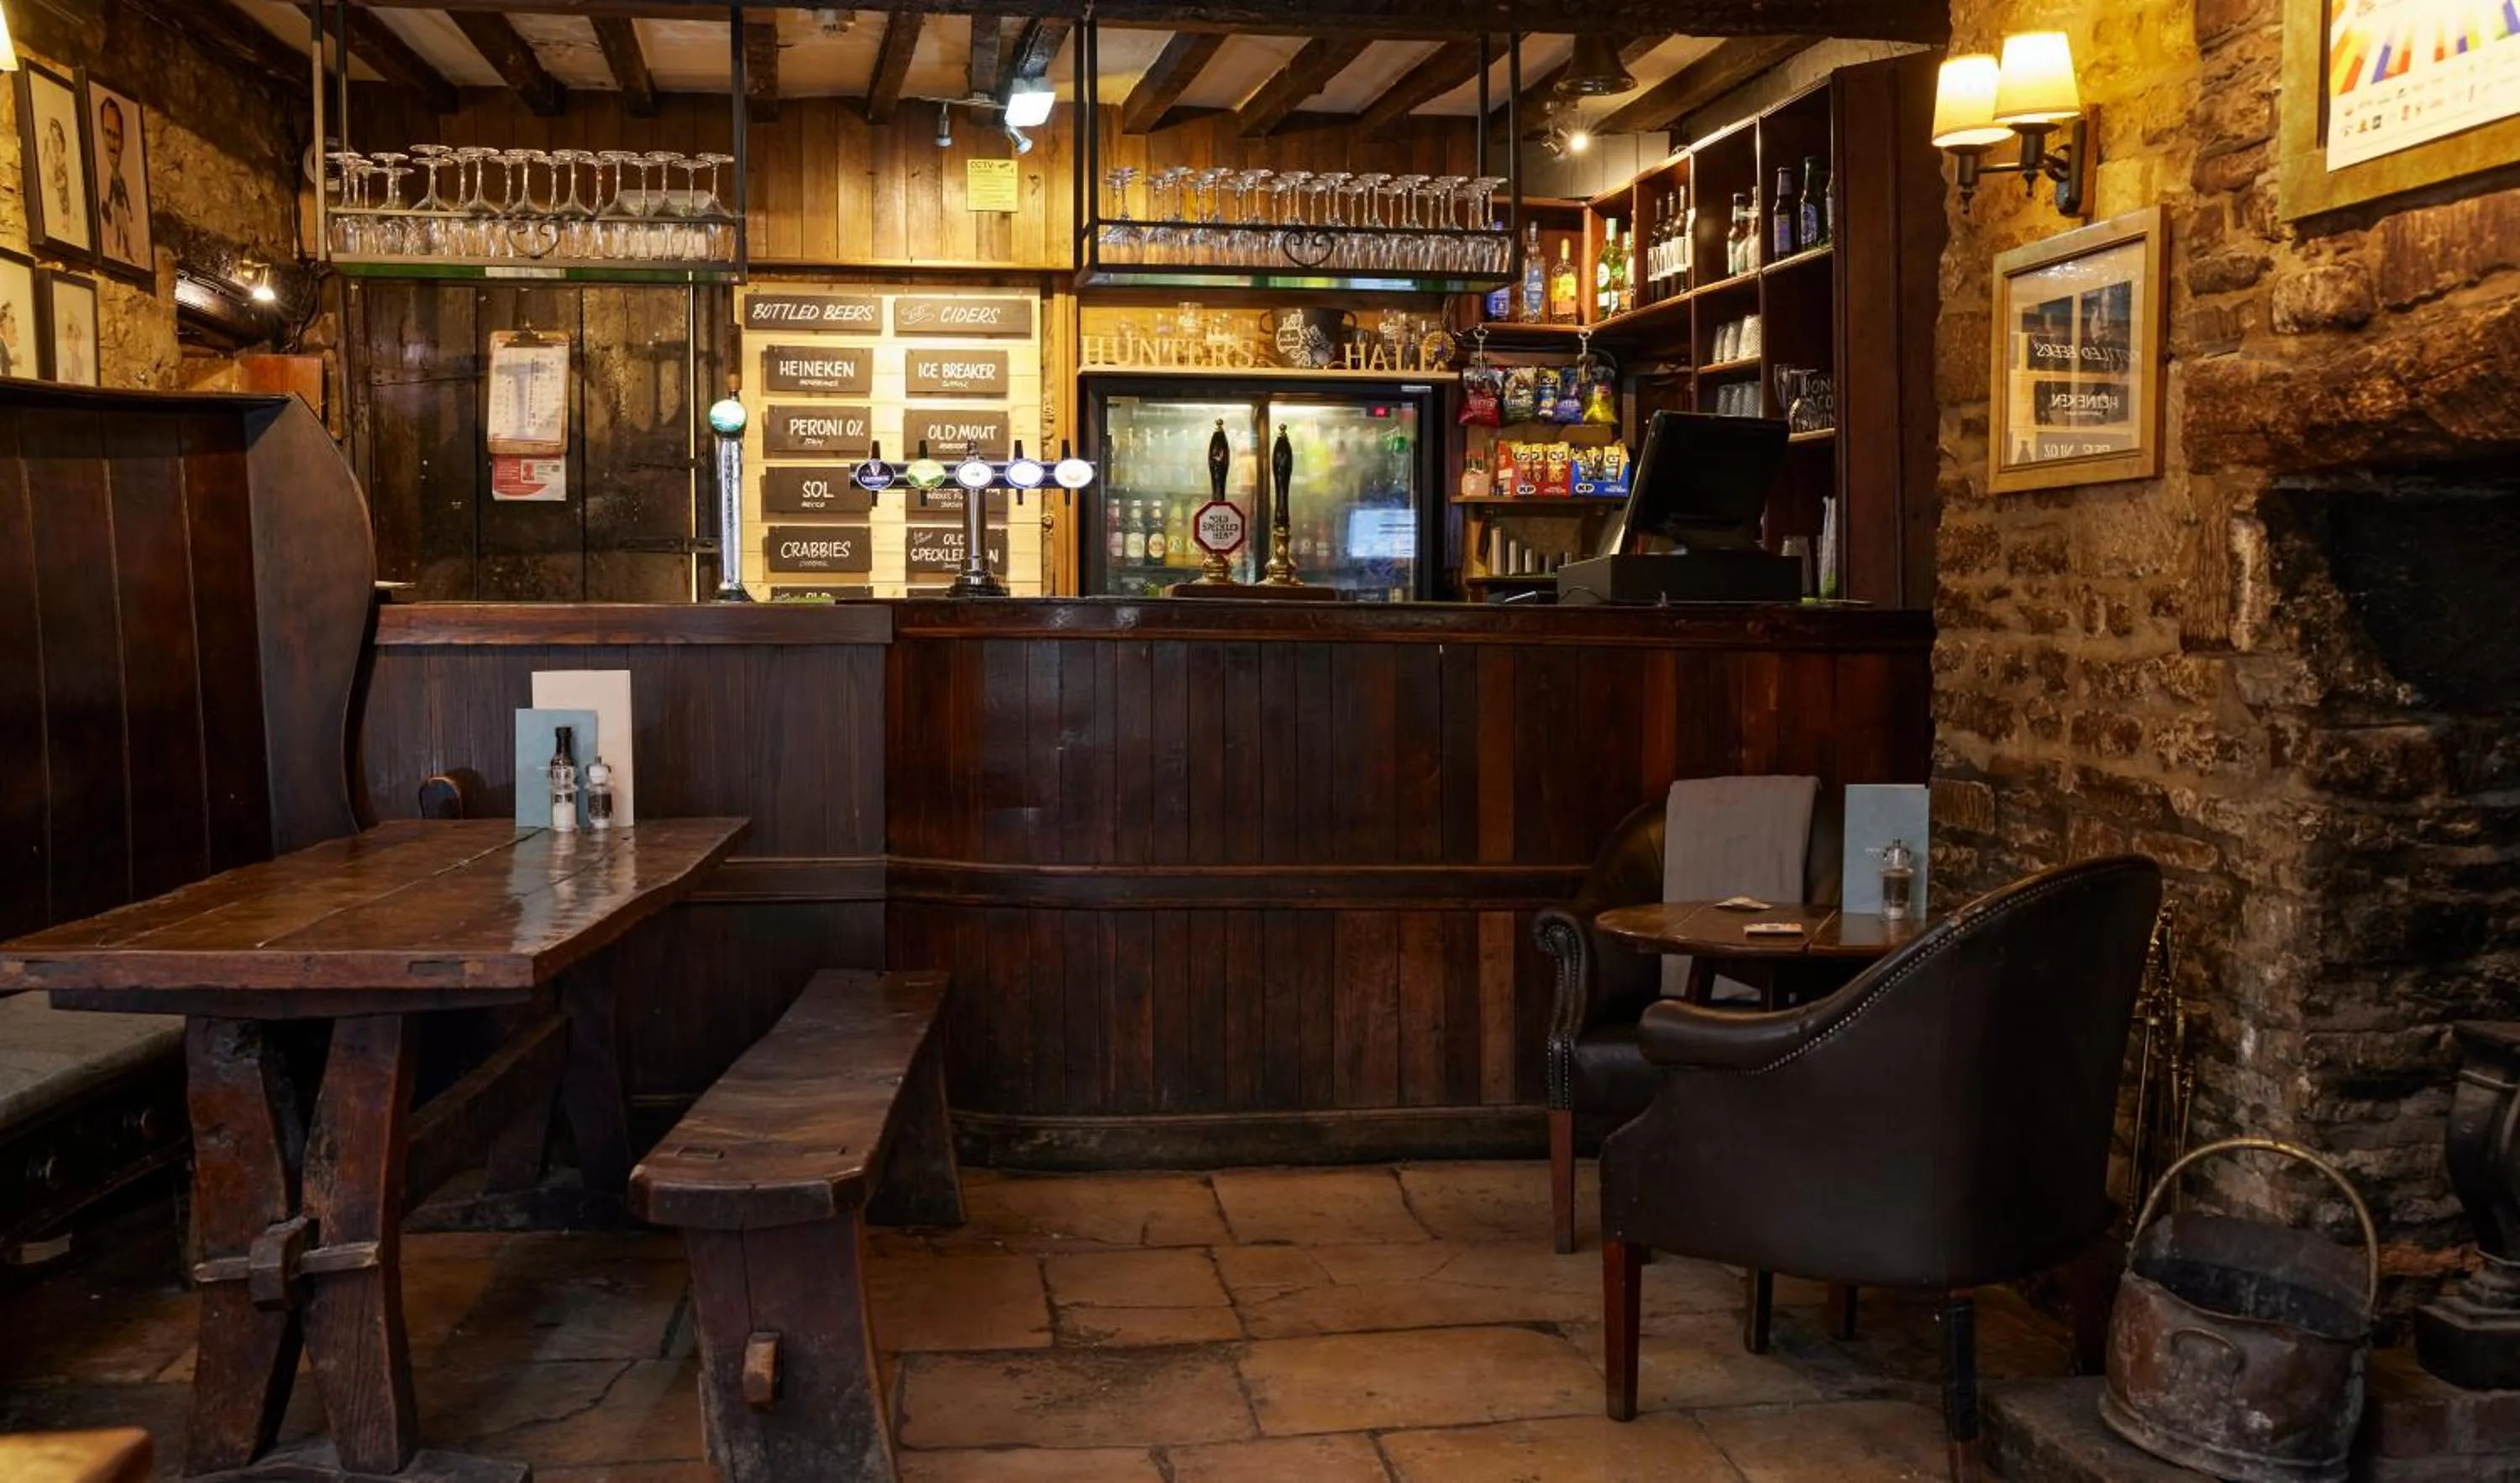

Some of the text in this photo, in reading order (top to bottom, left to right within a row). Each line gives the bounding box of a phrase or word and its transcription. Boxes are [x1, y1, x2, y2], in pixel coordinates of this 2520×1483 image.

[753, 303, 874, 322] BOTTLED BEERS
[940, 306, 1000, 324] CIDERS
[1082, 336, 1254, 368] HUNTERS
[779, 360, 855, 377] HEINEKEN
[918, 362, 996, 380] ICE BREAKER
[790, 418, 843, 436] PERONI
[928, 424, 998, 441] OLD MOUT
[802, 480, 834, 498] SOL
[780, 541, 851, 558] CRABBIES
